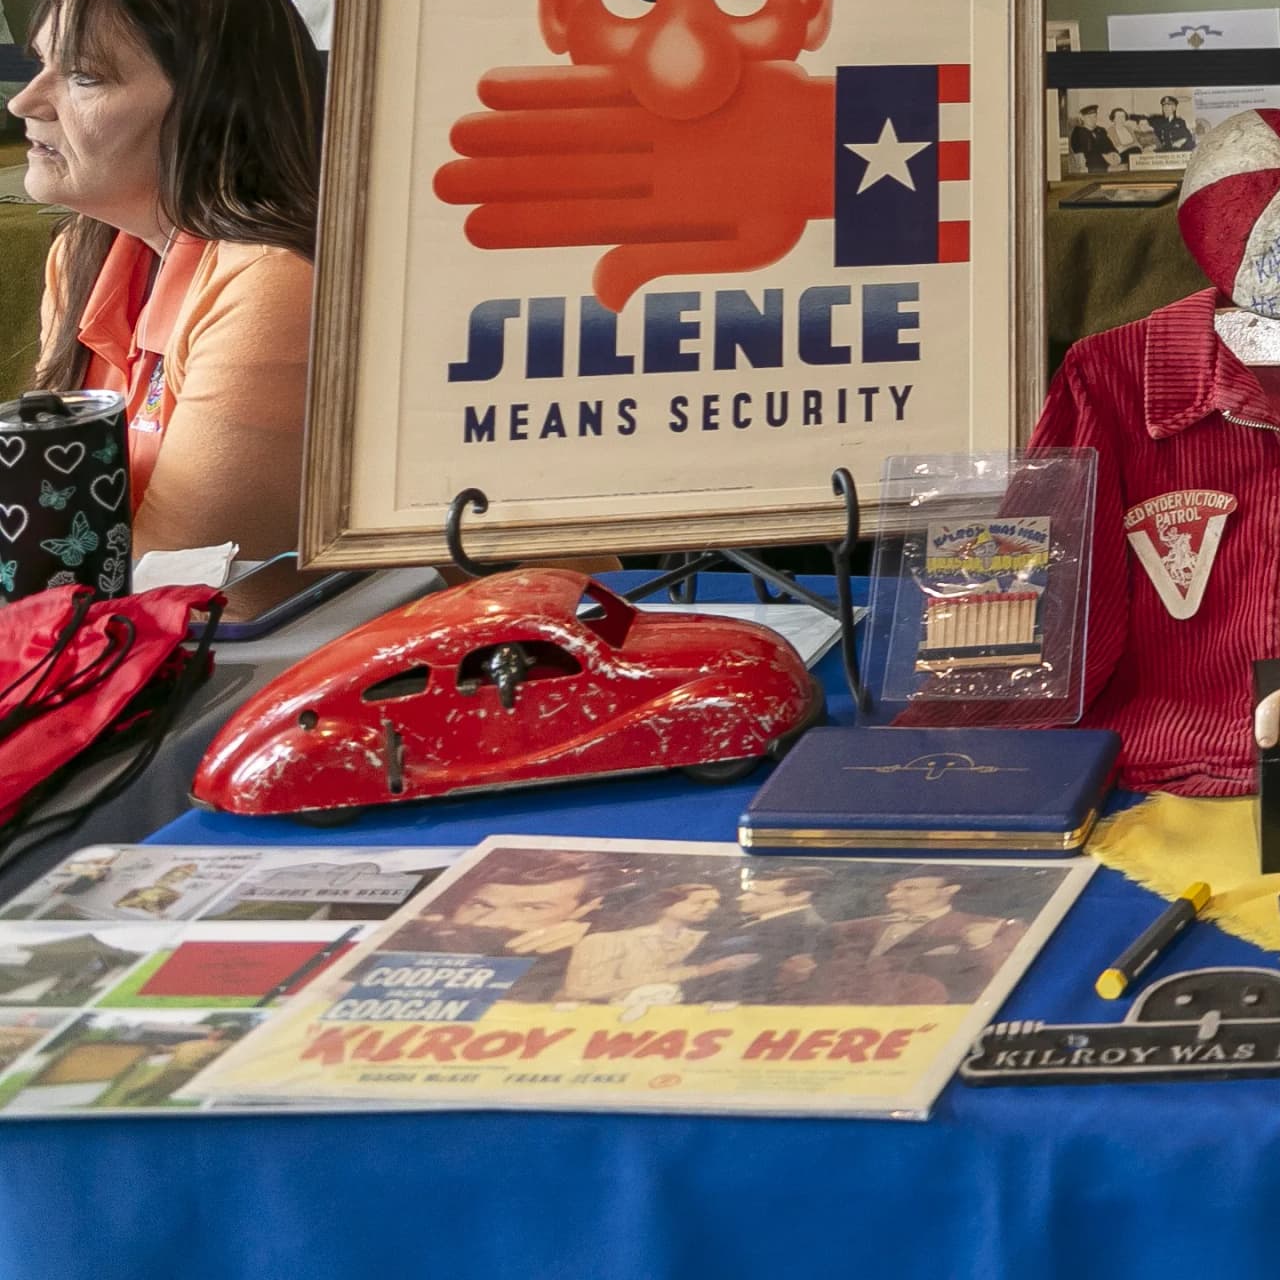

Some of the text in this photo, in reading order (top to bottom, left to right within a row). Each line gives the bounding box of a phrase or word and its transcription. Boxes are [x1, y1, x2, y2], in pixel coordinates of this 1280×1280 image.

[447, 282, 921, 382] SILENCE
[464, 385, 913, 443] MEANS SECURITY
[1146, 494, 1184, 517] RYDER
[1184, 492, 1233, 510] VICTORY
[1155, 508, 1201, 526] PATROL
[366, 967, 491, 988] COOPER
[330, 999, 471, 1021] COOGAN
[583, 1028, 731, 1062] WAS
[994, 1045, 1159, 1067] KILROY
[1168, 1042, 1255, 1063] WAS
